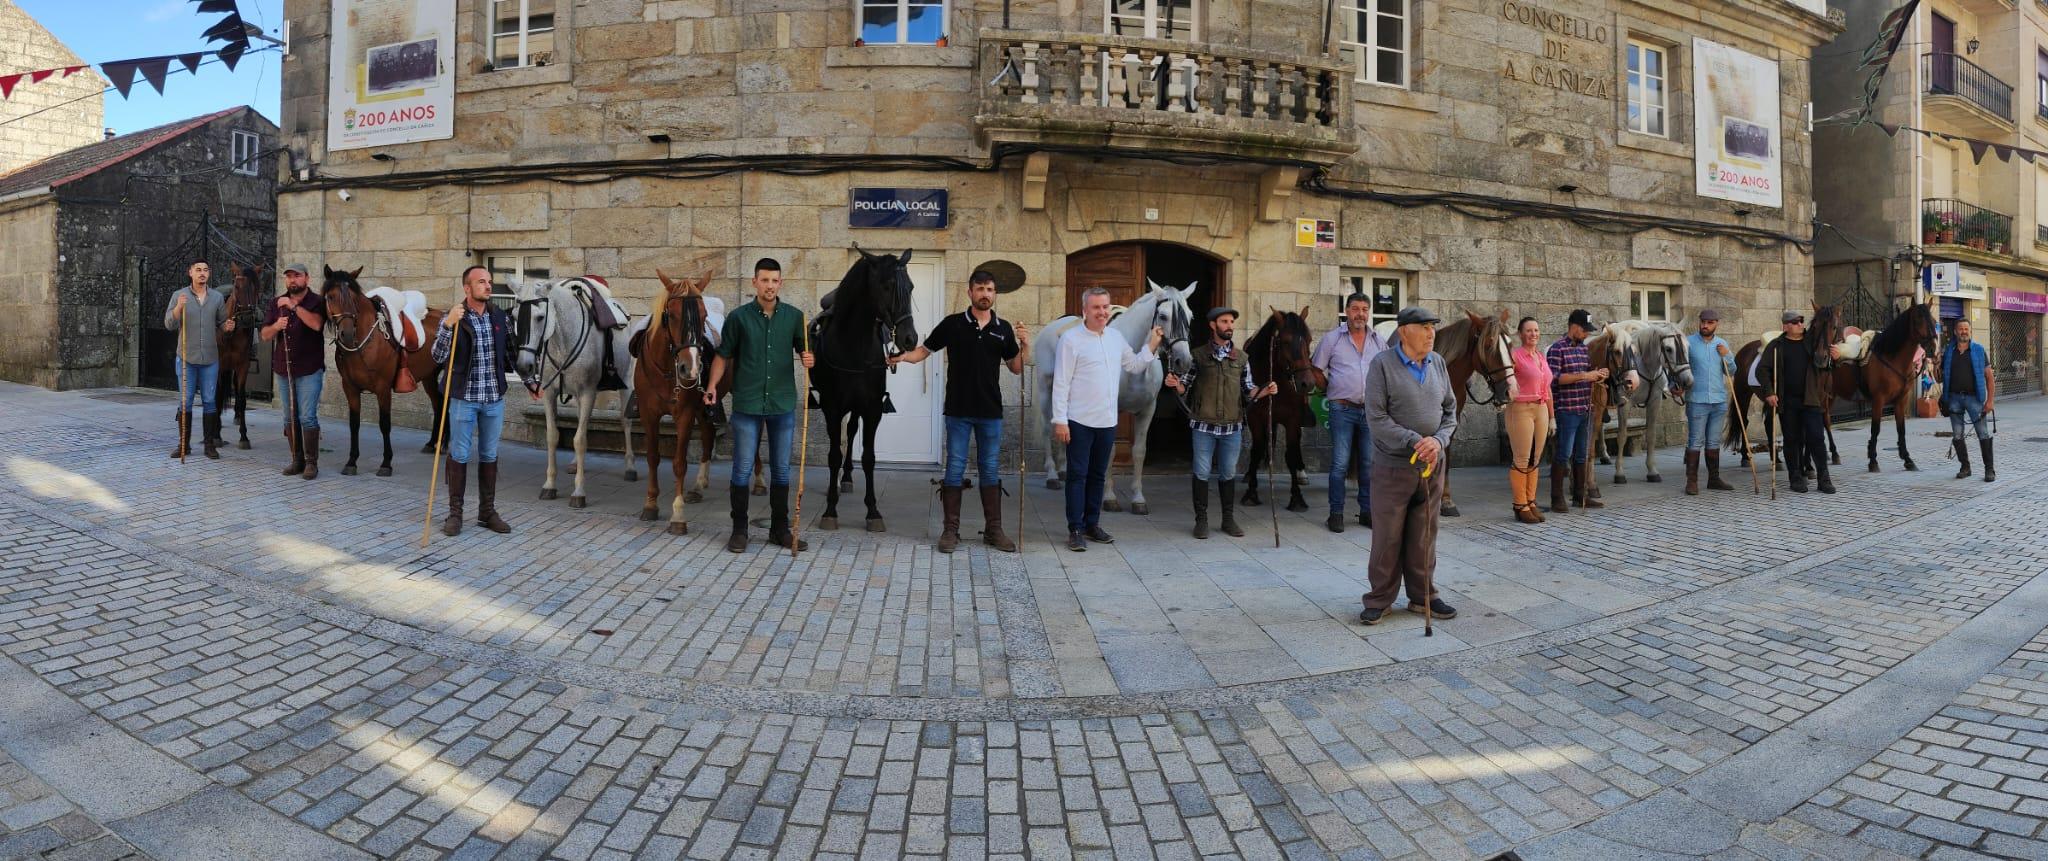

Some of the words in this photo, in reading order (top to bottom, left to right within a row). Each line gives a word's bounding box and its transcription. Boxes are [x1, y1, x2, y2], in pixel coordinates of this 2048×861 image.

[1503, 1, 1606, 43] CONCELLO
[1546, 39, 1569, 62] DE
[1504, 60, 1520, 81] A
[358, 112, 386, 128] 200
[388, 105, 435, 123] ANOS
[1720, 170, 1738, 184] 200
[1740, 175, 1770, 190] ANOS
[855, 199, 898, 210] POLICÍA
[906, 201, 941, 211] LOCAL
